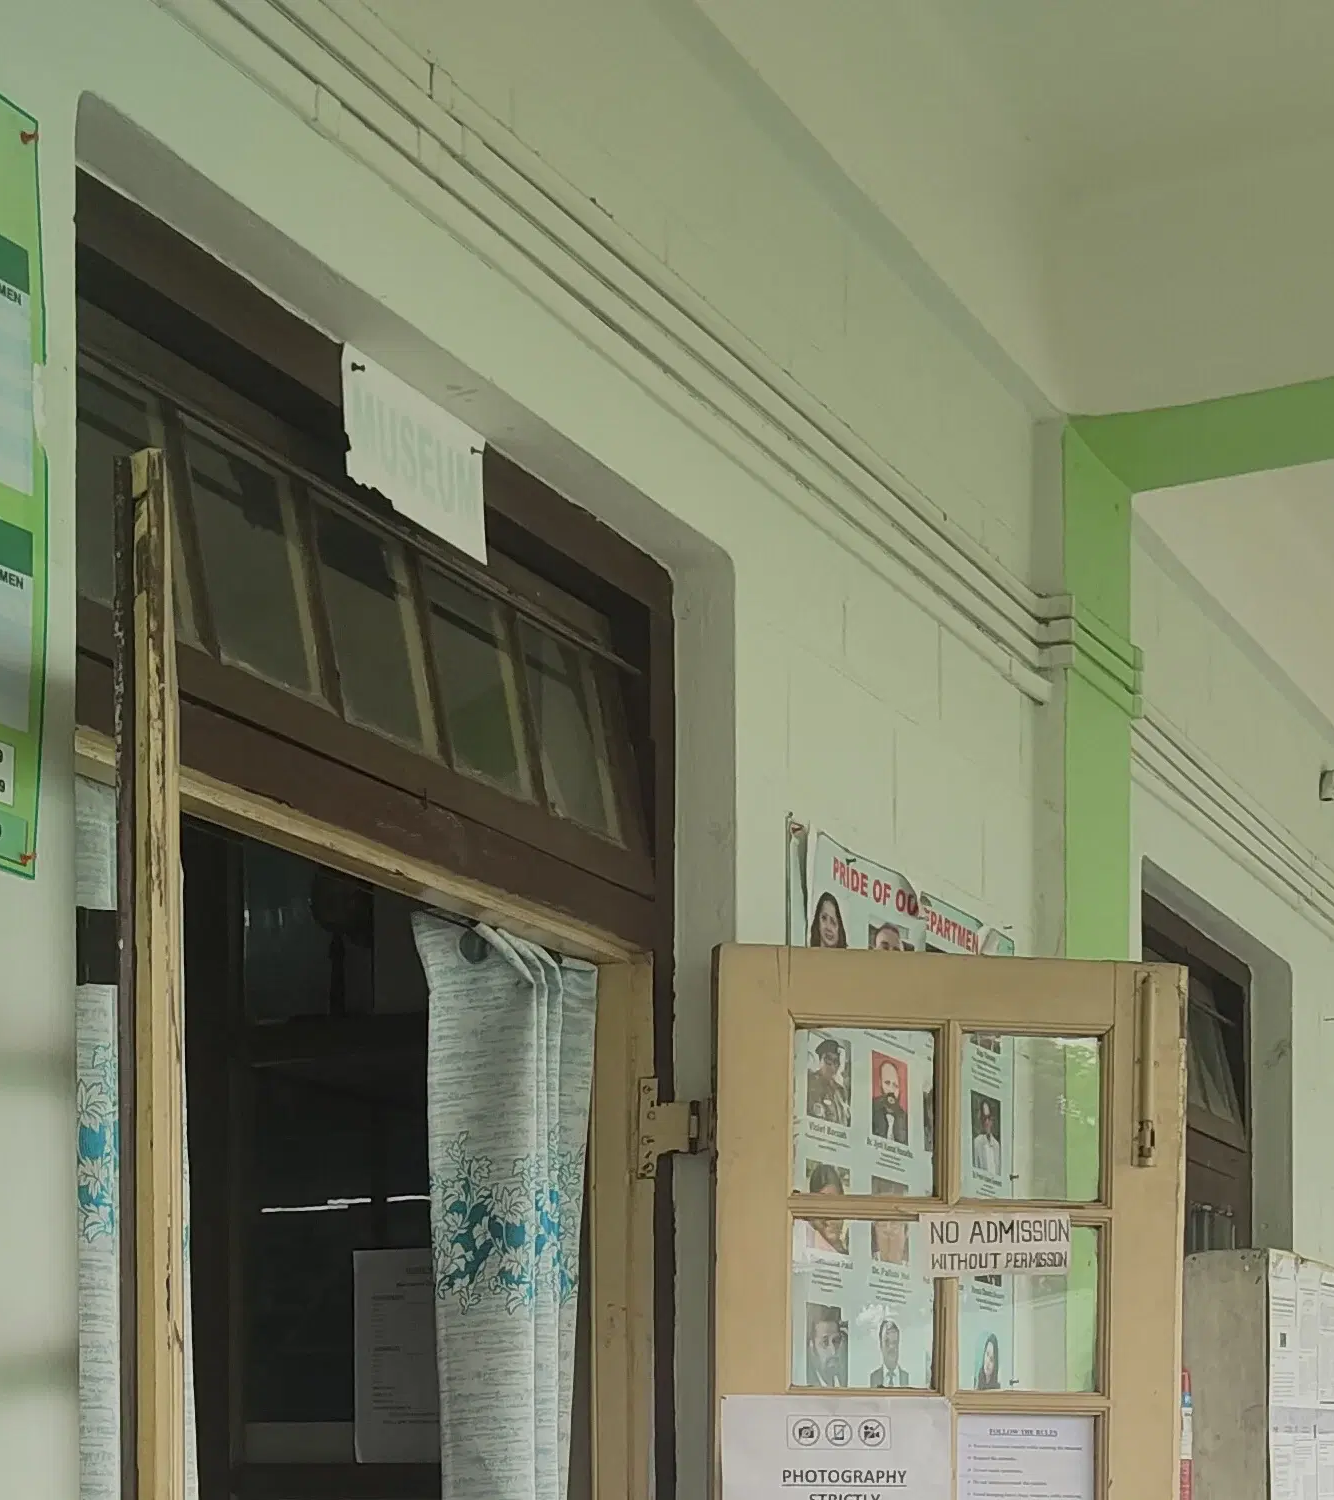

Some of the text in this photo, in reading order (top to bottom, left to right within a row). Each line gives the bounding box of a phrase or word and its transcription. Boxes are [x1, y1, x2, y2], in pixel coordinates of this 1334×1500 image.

[352, 382, 481, 518] MUSEUM
[833, 856, 868, 898] PRIDE
[872, 879, 892, 906] OF
[930, 1219, 1070, 1244] NO ADMISSION
[931, 1252, 1001, 1270] WITHOUT
[782, 1469, 908, 1485] PHOTOGRAPHY
